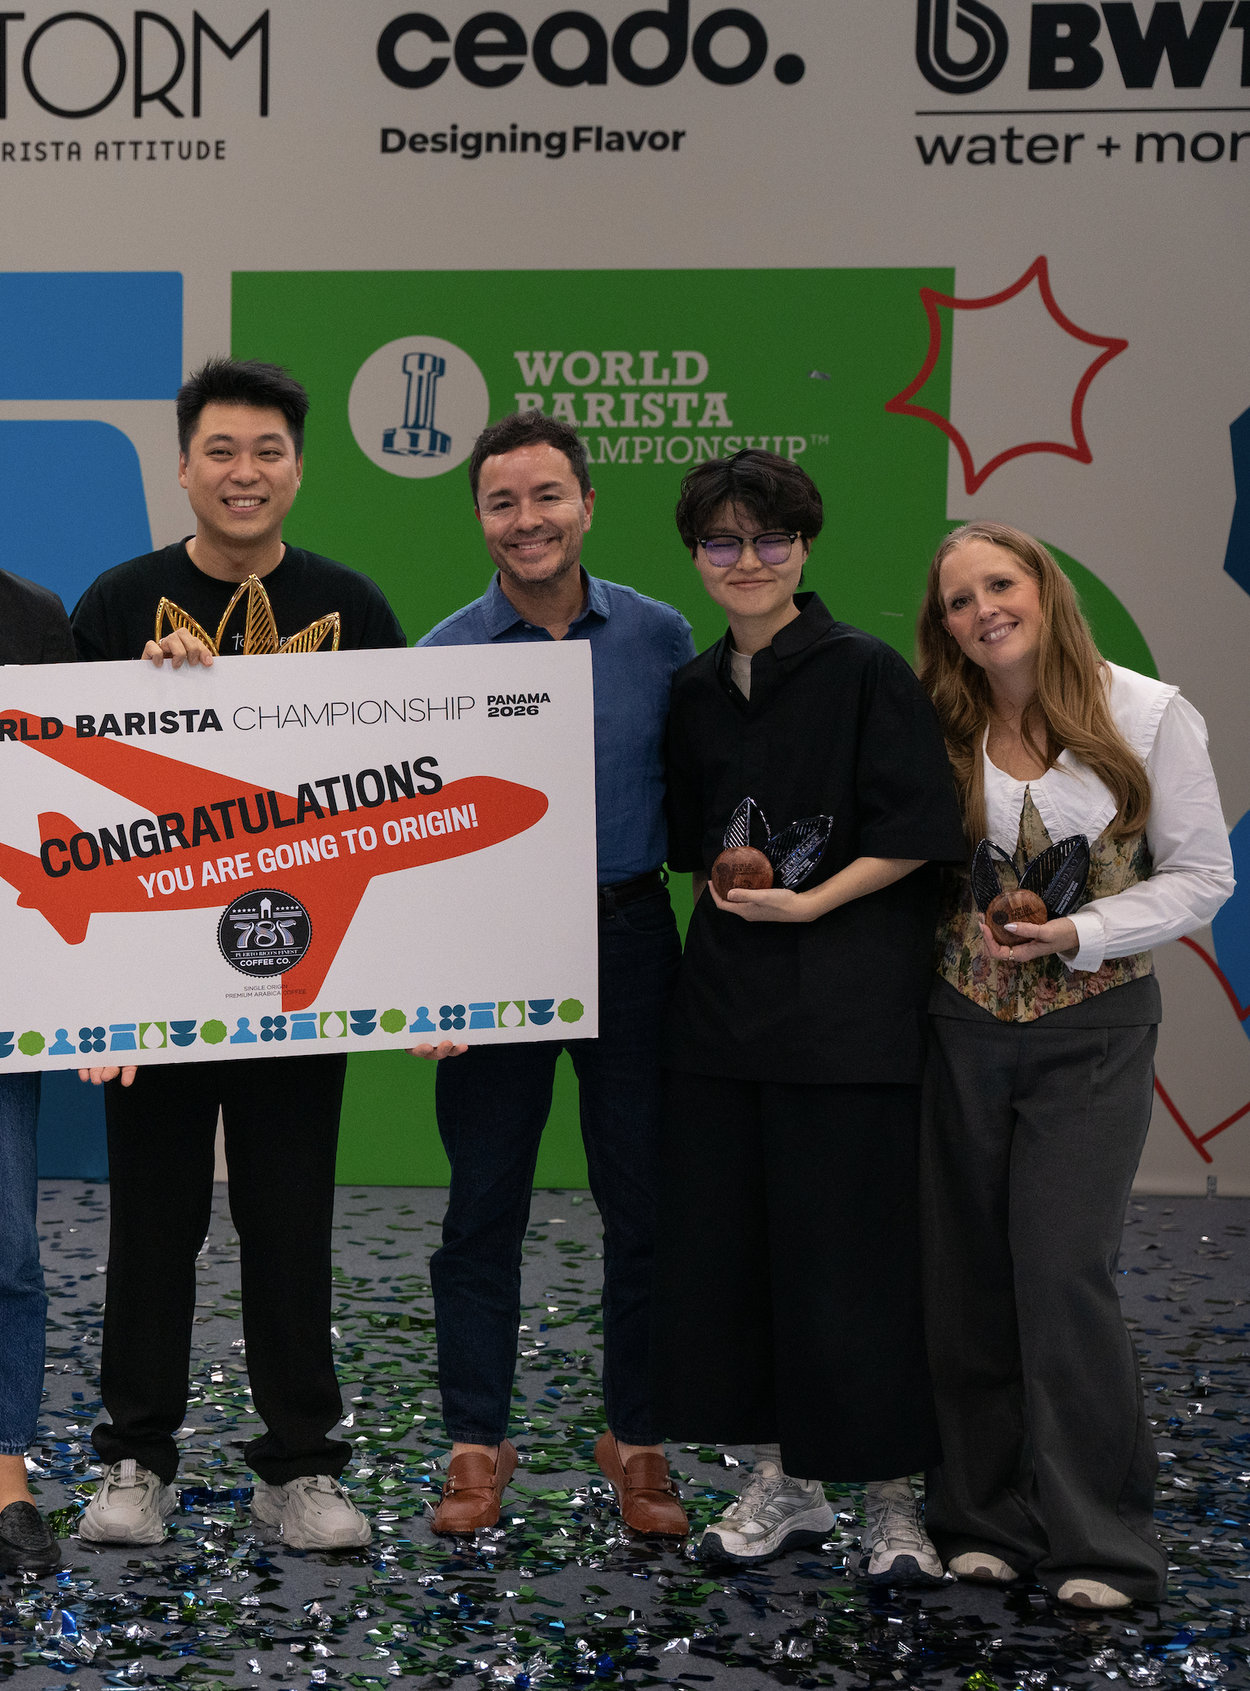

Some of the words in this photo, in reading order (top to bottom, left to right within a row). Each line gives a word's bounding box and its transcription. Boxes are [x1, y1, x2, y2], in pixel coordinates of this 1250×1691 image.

[376, 0, 806, 89] ceado.
[94, 140, 226, 162] ATTITUDE
[914, 126, 1085, 165] water
[514, 350, 709, 386] WORLD
[514, 392, 733, 428] BARISTA
[578, 435, 807, 464] MPIONSHIP
[486, 692, 551, 706] PANAMA
[487, 705, 540, 718] 2026
[75, 708, 223, 738] BARISTA
[232, 695, 476, 731] CHAMPIONSHIP
[40, 755, 444, 878] CONGRATULATIONS
[138, 864, 195, 899] YOU
[200, 852, 254, 887] ARE
[257, 833, 339, 873] GOING
[341, 825, 378, 855] TO
[382, 802, 479, 847] ORIGIN!
[240, 958, 274, 967] COFFEE
[276, 957, 291, 965] CO.
[243, 984, 265, 992] SINGLE
[266, 983, 288, 991] ORIGIN
[254, 990, 281, 998] ARABICA
[283, 988, 307, 996] COFFEE
